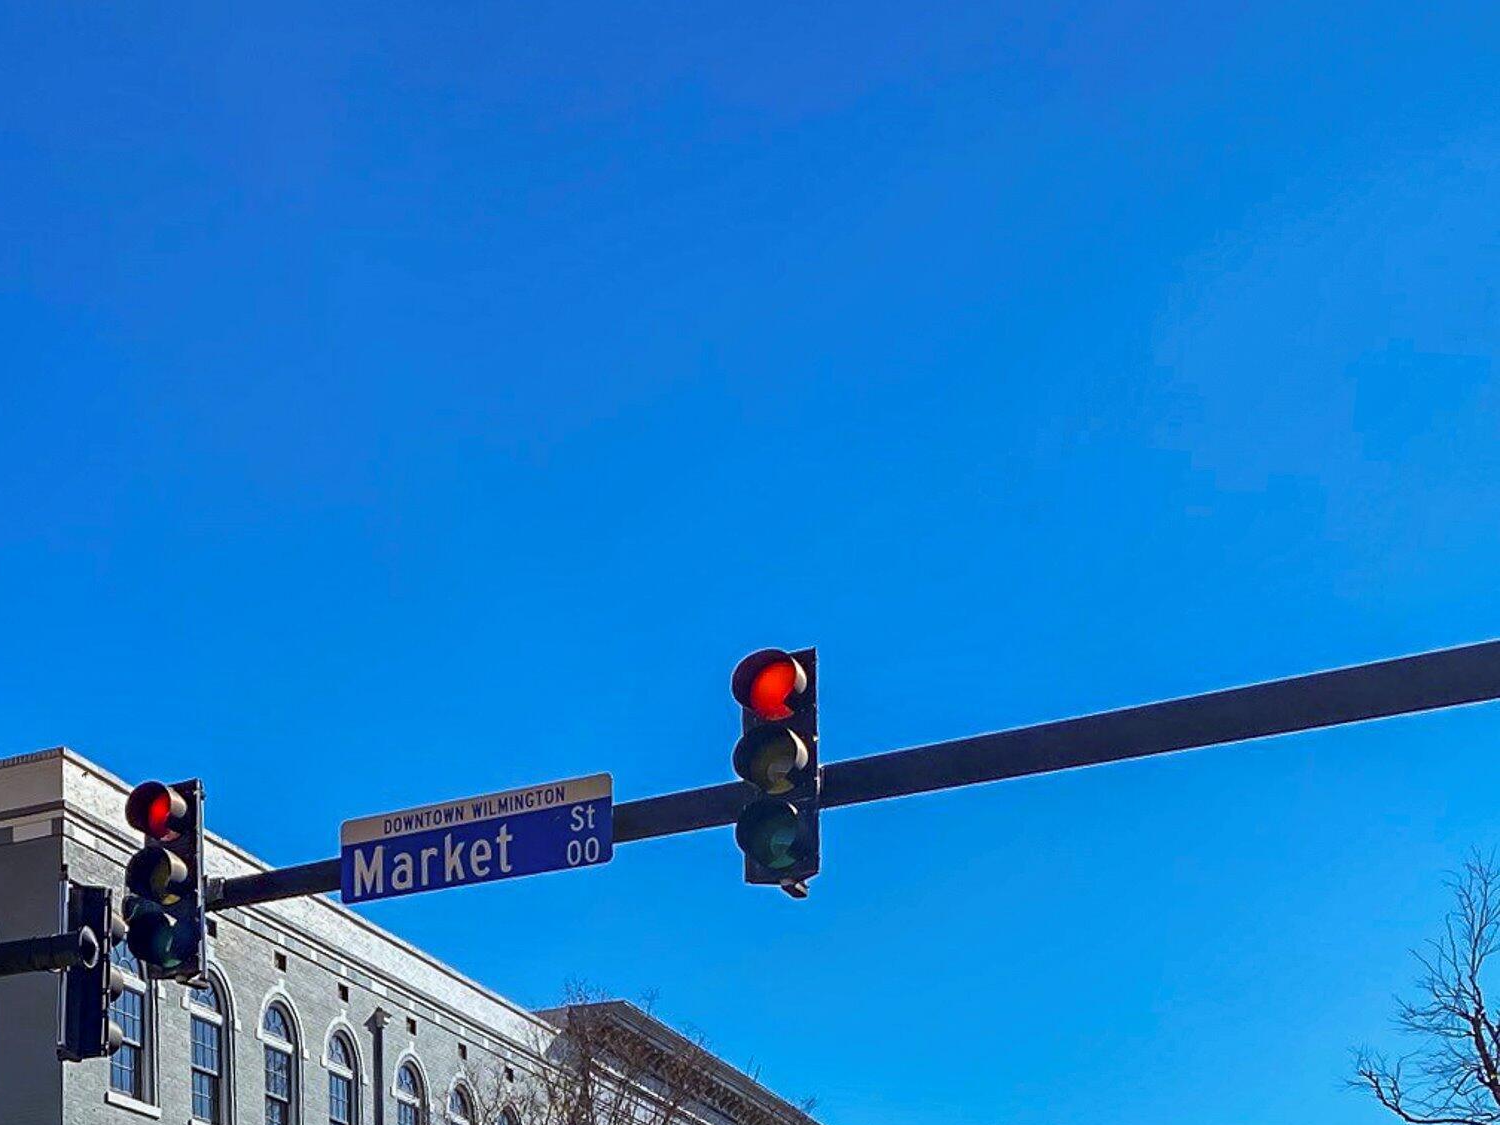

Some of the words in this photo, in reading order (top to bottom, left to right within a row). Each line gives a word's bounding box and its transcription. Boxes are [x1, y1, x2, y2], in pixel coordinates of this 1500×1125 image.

[383, 805, 465, 835] DOWNTOWN
[471, 786, 566, 819] WILMINGTON
[353, 823, 514, 898] Market
[570, 804, 596, 832] St
[567, 837, 600, 867] 00
